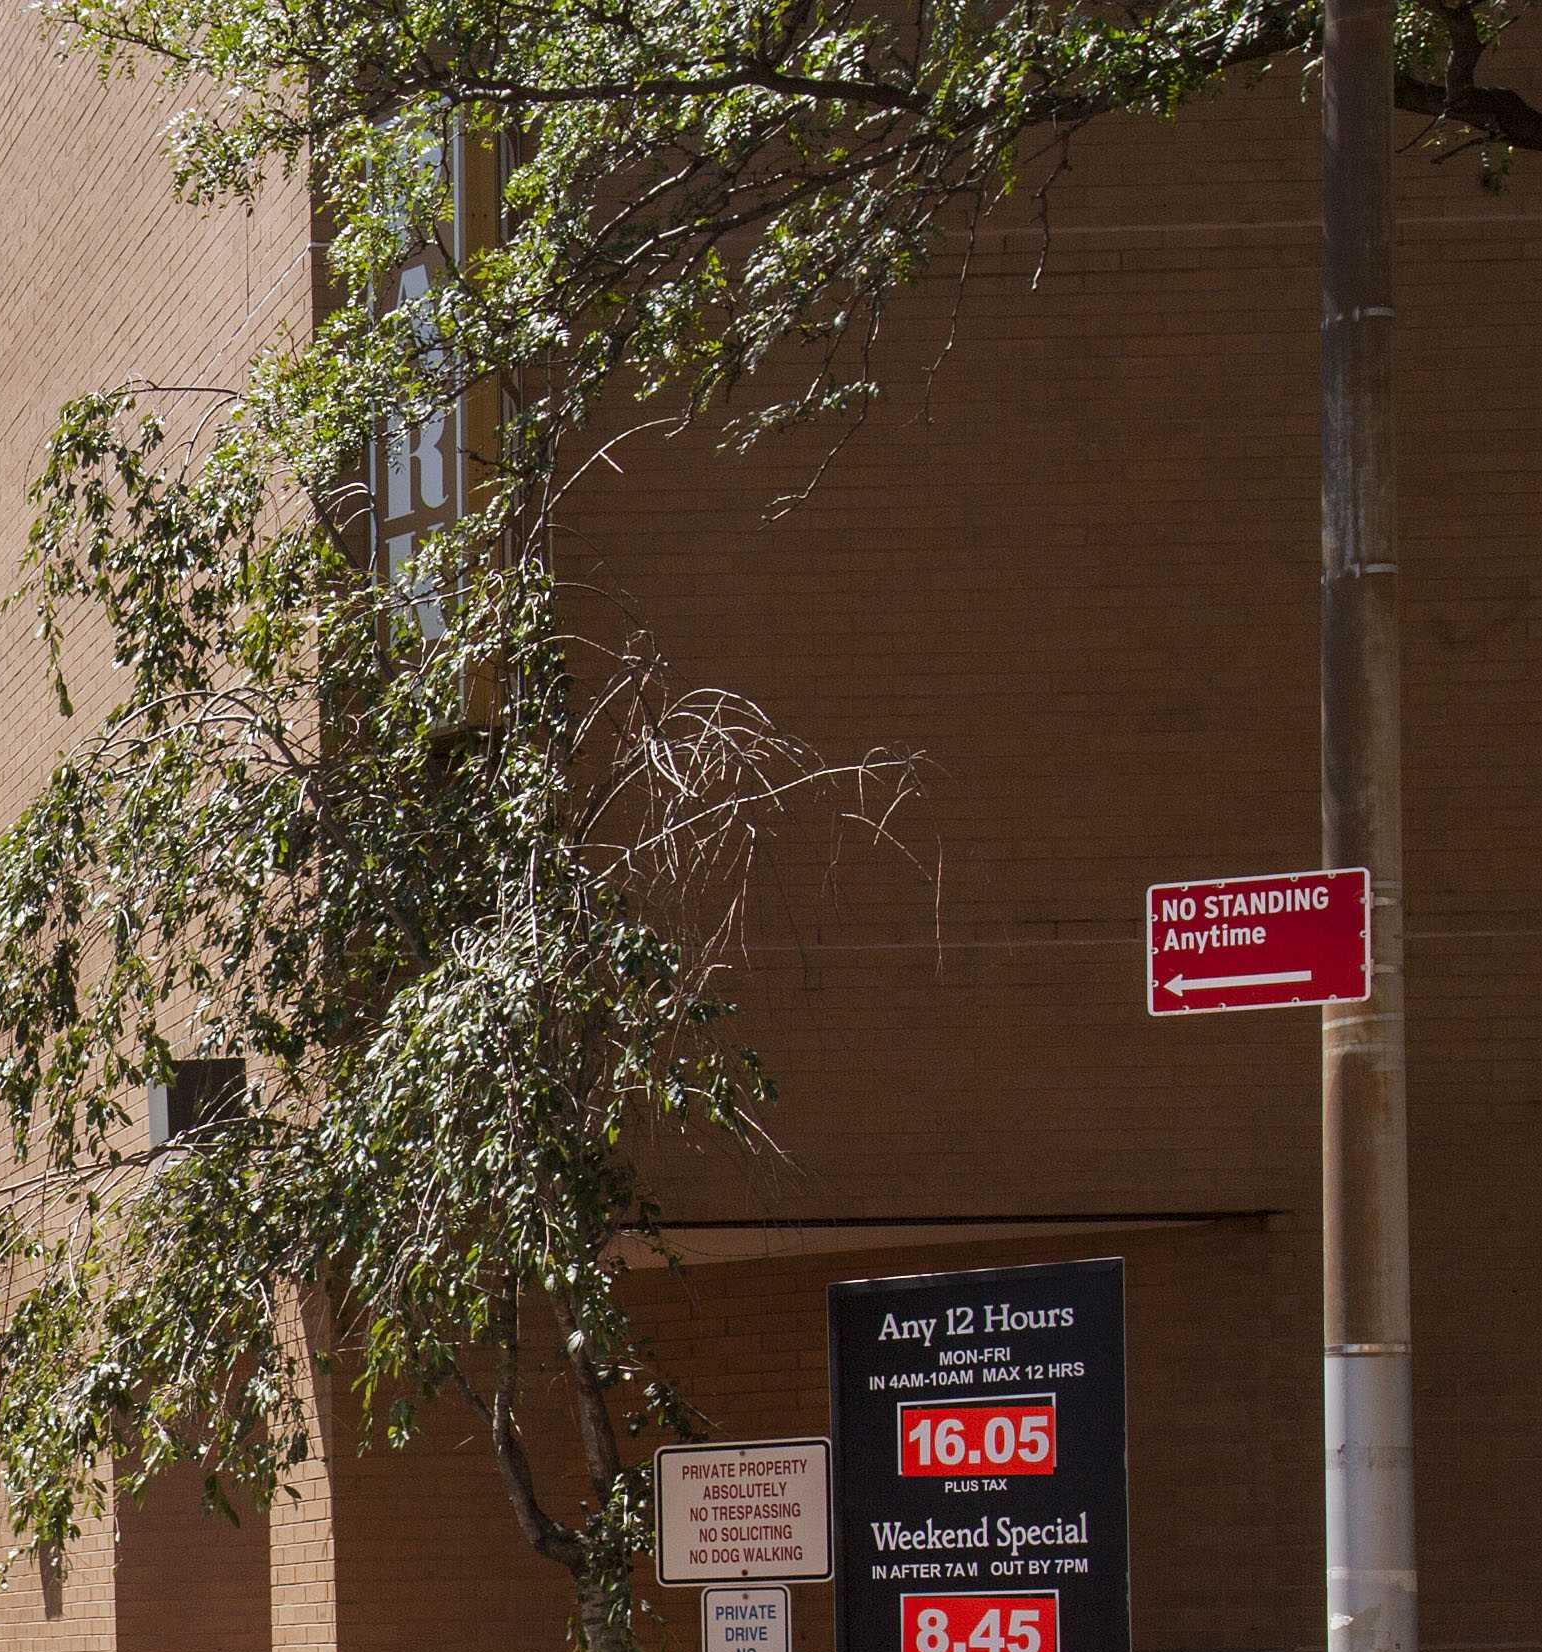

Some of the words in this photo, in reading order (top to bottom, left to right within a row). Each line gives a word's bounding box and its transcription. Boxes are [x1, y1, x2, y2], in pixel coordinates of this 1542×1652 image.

[1162, 897, 1197, 922] NO
[1204, 886, 1330, 918] STANDING
[1163, 923, 1267, 954] Anytime
[878, 1312, 937, 1347] Any
[946, 1307, 974, 1336] 12
[984, 1304, 1075, 1333] Hours
[939, 1347, 1011, 1367] MON-FRI
[869, 1375, 885, 1391] IN
[889, 1369, 974, 1389] 4AM-10AM
[982, 1366, 1021, 1384] MAX
[1024, 1364, 1045, 1381] 12
[1048, 1362, 1085, 1379] HRS
[909, 1415, 1050, 1466] 16.05
[681, 1463, 736, 1481] PRIVATE
[739, 1459, 808, 1478] PROPERTY
[703, 1482, 787, 1501] ABSOLUTELY
[945, 1480, 979, 1493] PLUS
[982, 1478, 1008, 1492] TAX
[690, 1506, 709, 1522] NO
[712, 1502, 802, 1521] TRESPASSING
[699, 1527, 718, 1543] NO
[720, 1524, 793, 1542] SOLICITING
[870, 1516, 989, 1552] Weekend
[996, 1512, 1089, 1557] Special
[689, 1549, 709, 1565] NO
[711, 1548, 740, 1564] DOG
[743, 1546, 803, 1564] WALKING
[872, 1564, 887, 1580] IN
[890, 1563, 942, 1579] AFTER
[990, 1560, 1025, 1577] OUT
[1029, 1560, 1052, 1575] BY
[1054, 1558, 1089, 1574] 7PM
[715, 1604, 777, 1621] PRIVATE
[725, 1626, 768, 1642] DRIVE
